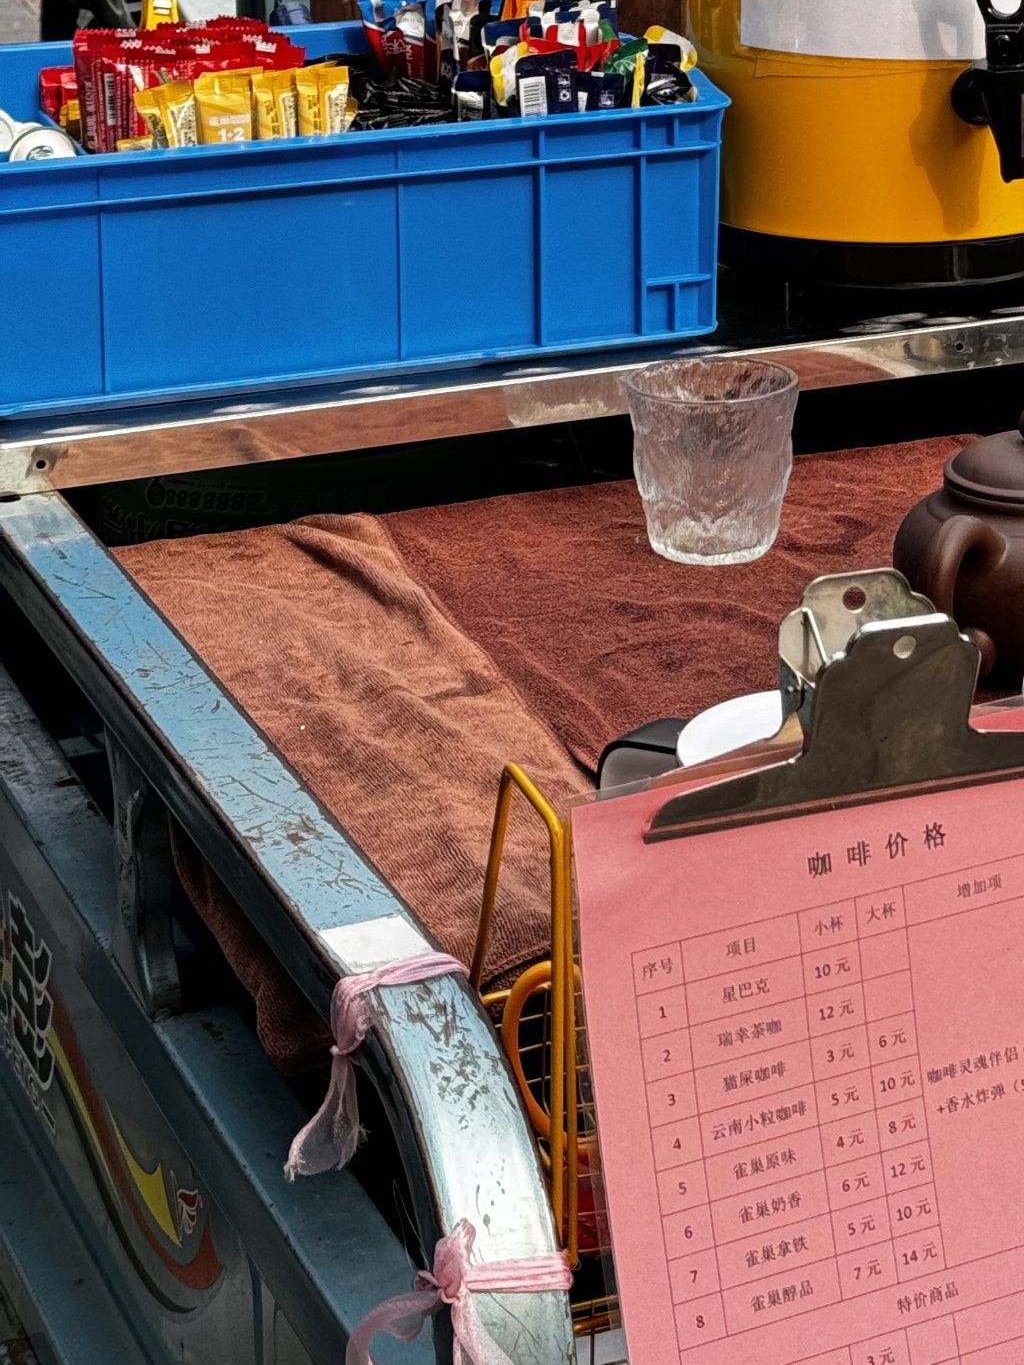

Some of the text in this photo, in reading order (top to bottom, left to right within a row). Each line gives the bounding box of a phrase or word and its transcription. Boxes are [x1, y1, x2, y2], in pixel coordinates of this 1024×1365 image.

[807, 821, 946, 879] 咖啡价格
[641, 957, 674, 981] 序号
[725, 937, 757, 959] 项目
[813, 915, 844, 937] 小杯
[864, 901, 897, 925] 大杯
[956, 873, 1003, 899] 增加项
[658, 1006, 667, 1019] 1
[722, 978, 771, 1003] 星巴克
[663, 1049, 672, 1062] 2
[667, 1093, 677, 1107] 3
[722, 1059, 786, 1092] 猫屎咖啡
[672, 1138, 682, 1151] 4
[711, 1099, 807, 1141] 云南小粒咖啡
[678, 1182, 687, 1195] 5
[733, 1148, 797, 1181] 雀巢原味
[684, 1226, 693, 1239] 6
[738, 1191, 802, 1224] 雀巢奶香
[690, 1271, 698, 1283] 7
[745, 1235, 809, 1269] 雀巢拿铁
[696, 1315, 705, 1328] 8
[751, 1279, 814, 1313] 雀巢醇品
[896, 1281, 959, 1314] 特价商品
